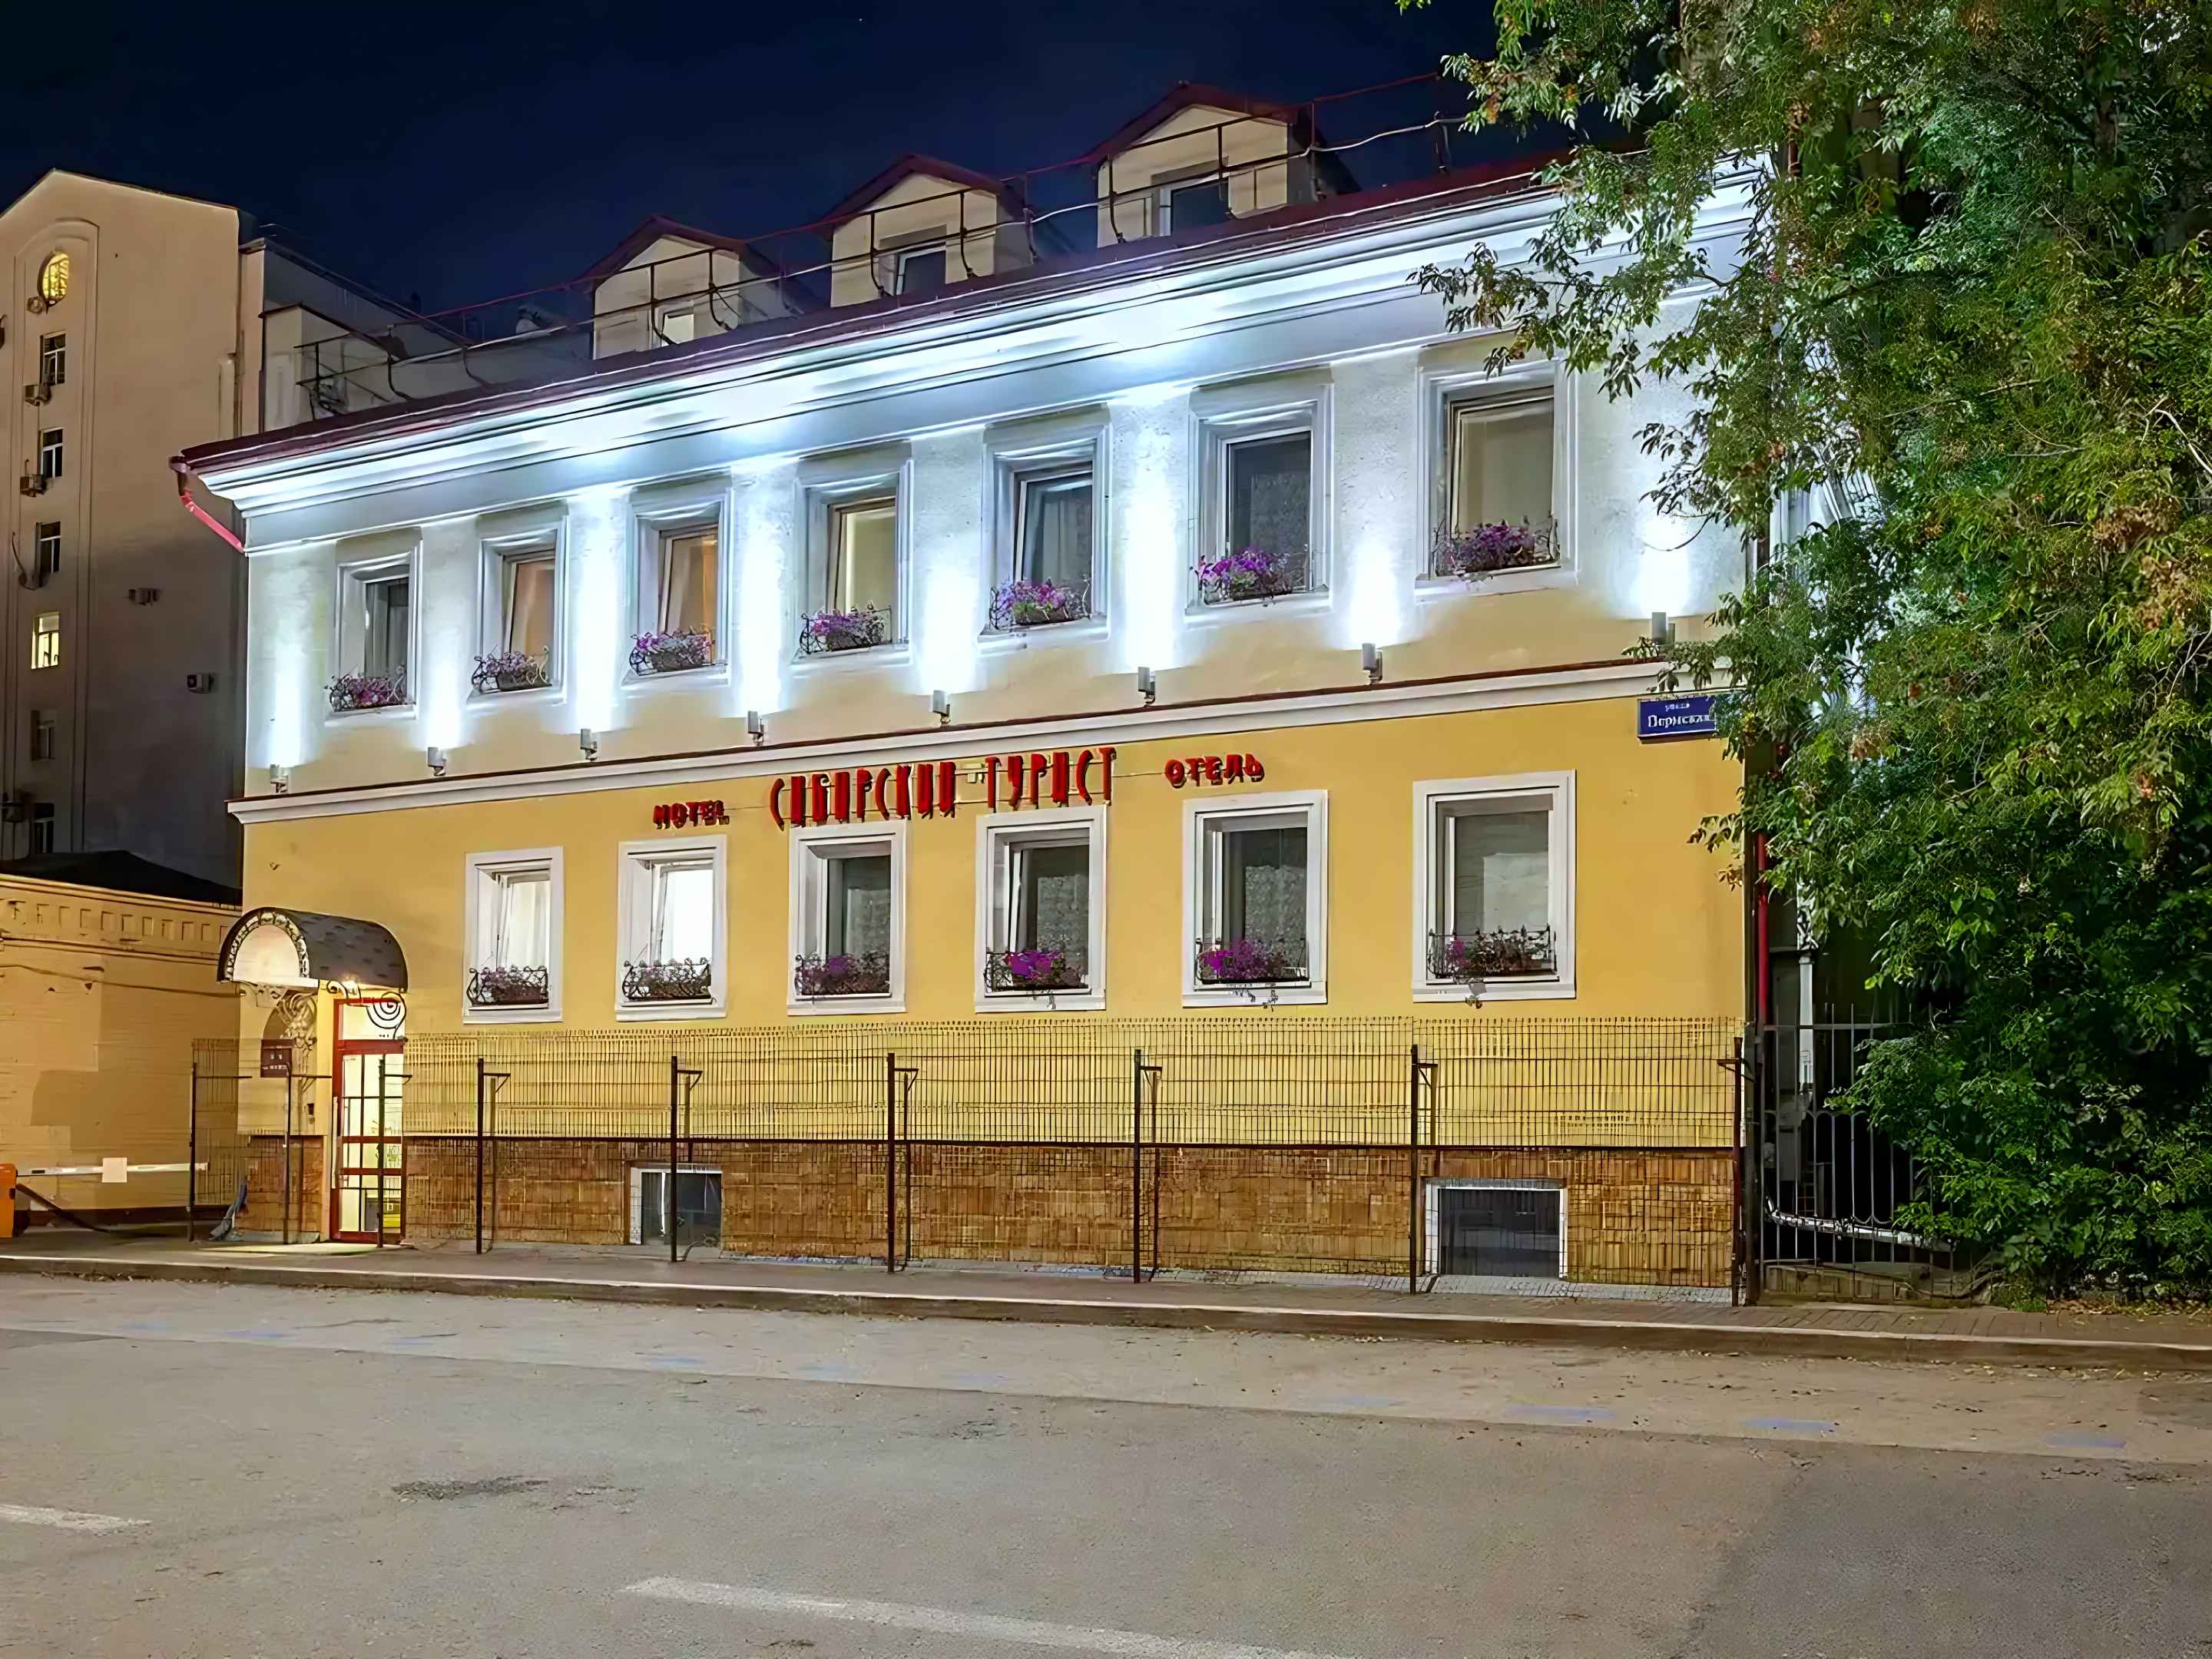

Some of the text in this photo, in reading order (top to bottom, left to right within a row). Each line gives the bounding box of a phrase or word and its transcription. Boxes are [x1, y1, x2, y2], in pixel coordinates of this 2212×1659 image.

[985, 747, 1117, 813] ТУРИСТ
[1164, 753, 1265, 789] ОТЕЛЬ
[653, 800, 730, 830] HOTEL
